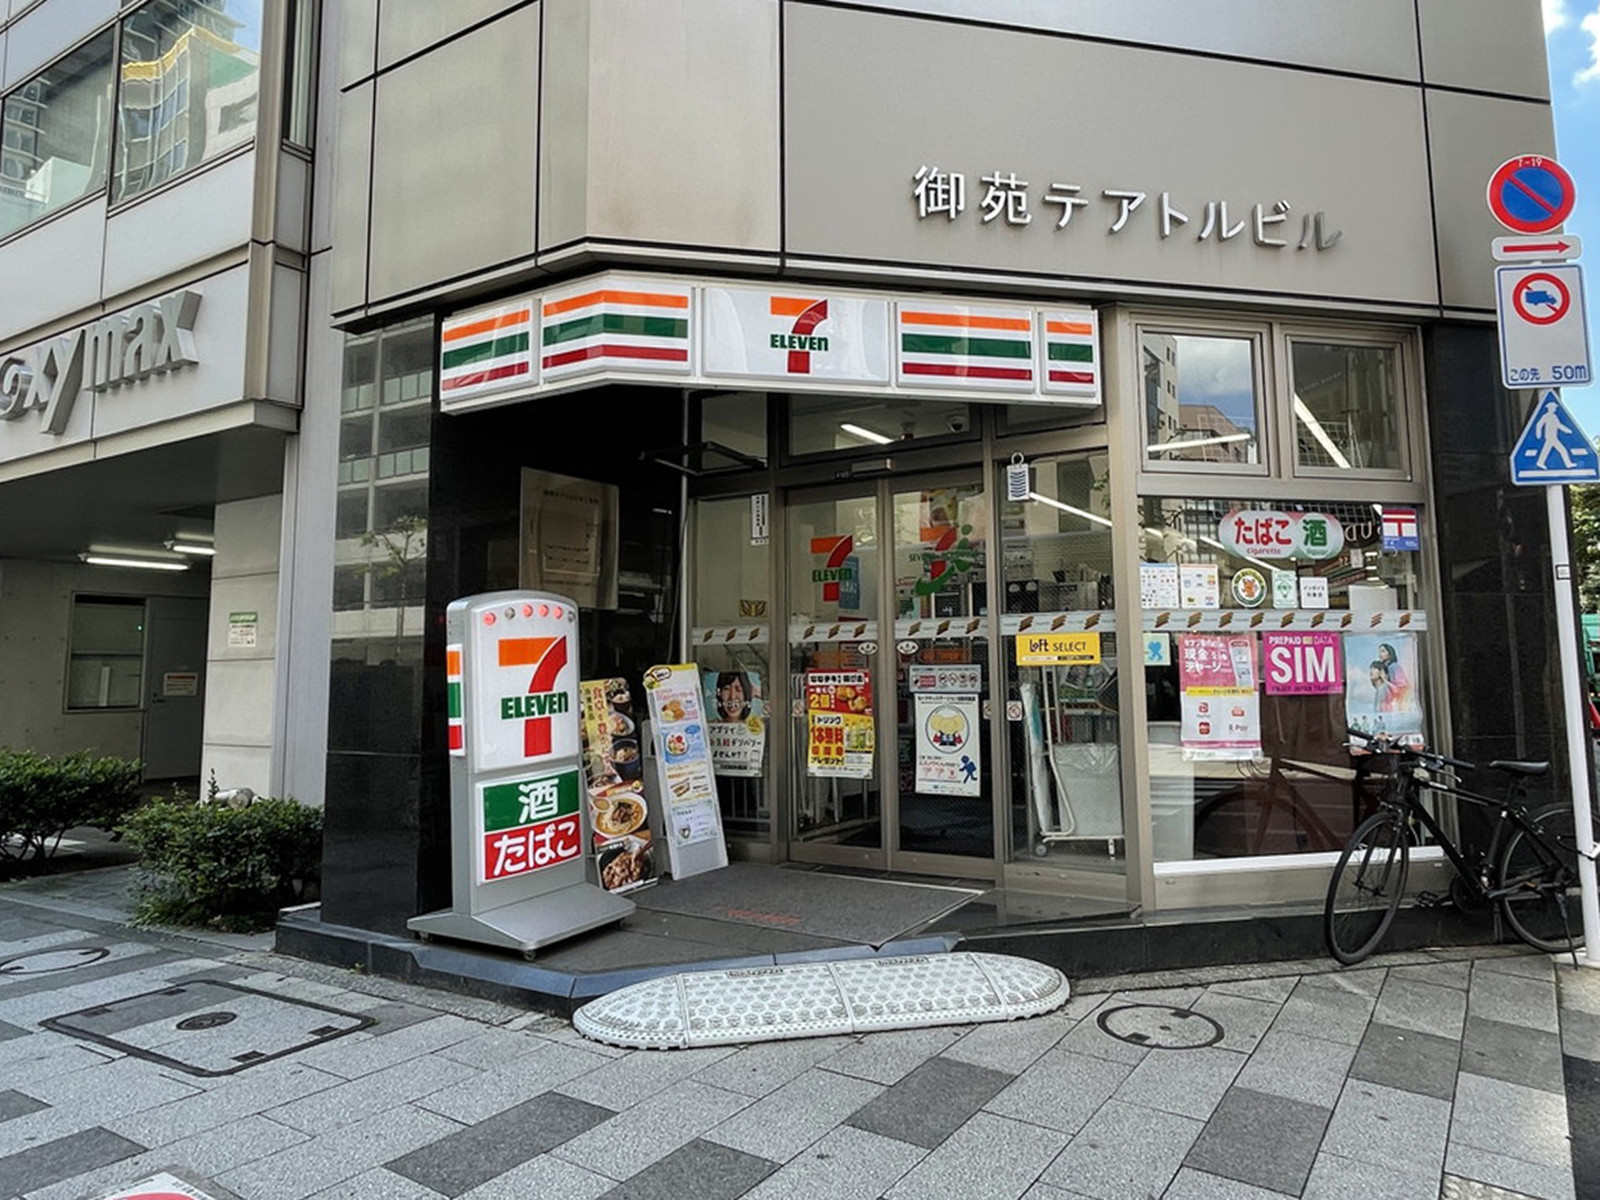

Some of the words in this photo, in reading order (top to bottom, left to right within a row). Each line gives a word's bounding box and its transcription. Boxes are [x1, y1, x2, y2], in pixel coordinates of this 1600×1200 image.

[1518, 157, 1542, 168] 7-19
[912, 165, 1342, 251] 御苑テアトルビル
[1509, 367, 1541, 382] この先
[1552, 364, 1587, 381] 50m
[1234, 517, 1292, 547] たばこ
[1302, 518, 1328, 547] 酒
[1246, 547, 1282, 556] cigarette
[1053, 642, 1087, 652] SELECT
[1269, 635, 1301, 645] PREPAID
[1270, 646, 1336, 684] SIM
[498, 635, 568, 758] 7
[518, 777, 560, 824] 酒
[493, 821, 578, 876] たばこ
